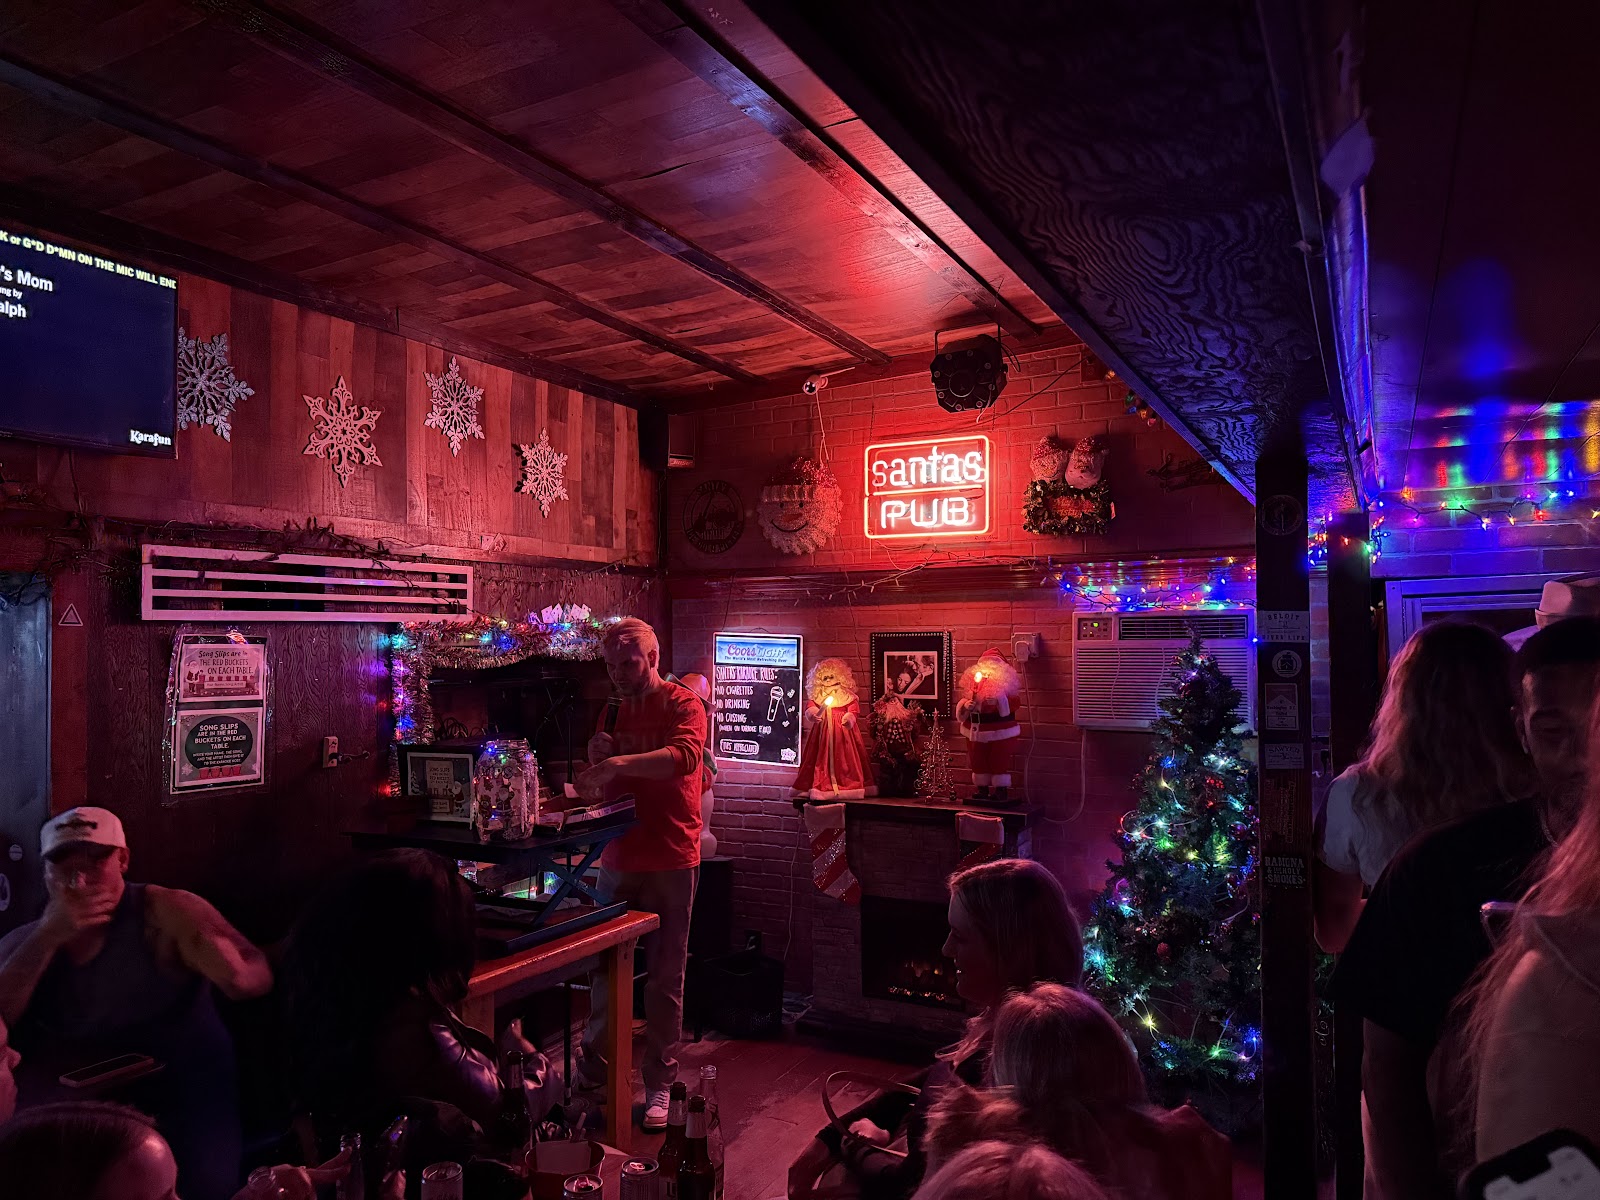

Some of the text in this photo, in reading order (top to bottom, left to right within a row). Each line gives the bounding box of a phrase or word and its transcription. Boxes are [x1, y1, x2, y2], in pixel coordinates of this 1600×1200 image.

[10, 235, 22, 245] or
[77, 253, 93, 266] ON
[94, 257, 115, 272] THE
[116, 263, 134, 278] MIC
[136, 269, 158, 284] WILL
[17, 269, 54, 292] Mom
[12, 288, 22, 300] by
[130, 429, 172, 446] Karafun
[872, 446, 982, 486] santas
[880, 496, 969, 529] PUB
[727, 643, 756, 656] Coors
[717, 686, 753, 695] NO CIGARETTES
[717, 699, 750, 709] NO DRINKING
[717, 712, 747, 723] NO CUSSING
[1265, 856, 1304, 868] RAMONA
[1267, 874, 1304, 885] SMOKES
